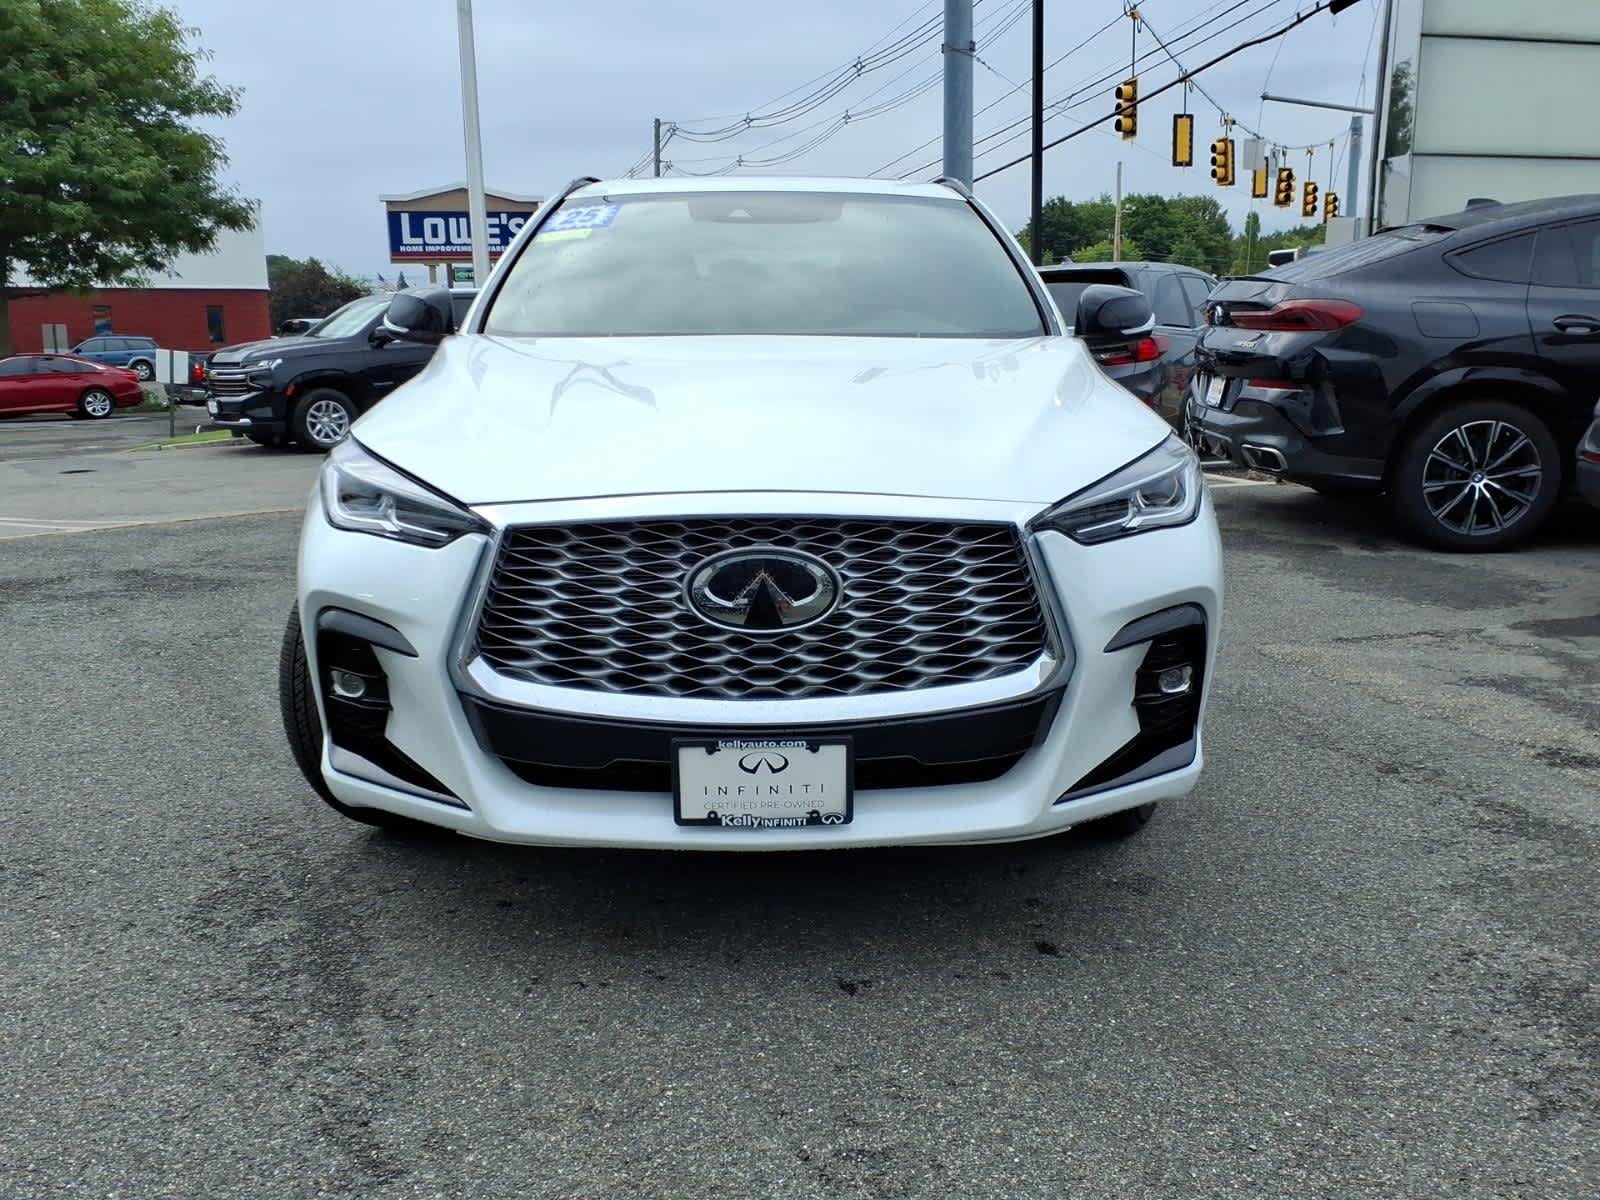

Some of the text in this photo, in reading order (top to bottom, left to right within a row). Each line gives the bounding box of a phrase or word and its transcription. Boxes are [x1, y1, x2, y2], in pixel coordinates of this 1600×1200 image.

[718, 740, 807, 751] kellyauto.com
[704, 783, 825, 796] INFINITI
[704, 799, 825, 810] CERTIFIED PRE-OWNED
[721, 814, 807, 828] Kelly INFINITI
